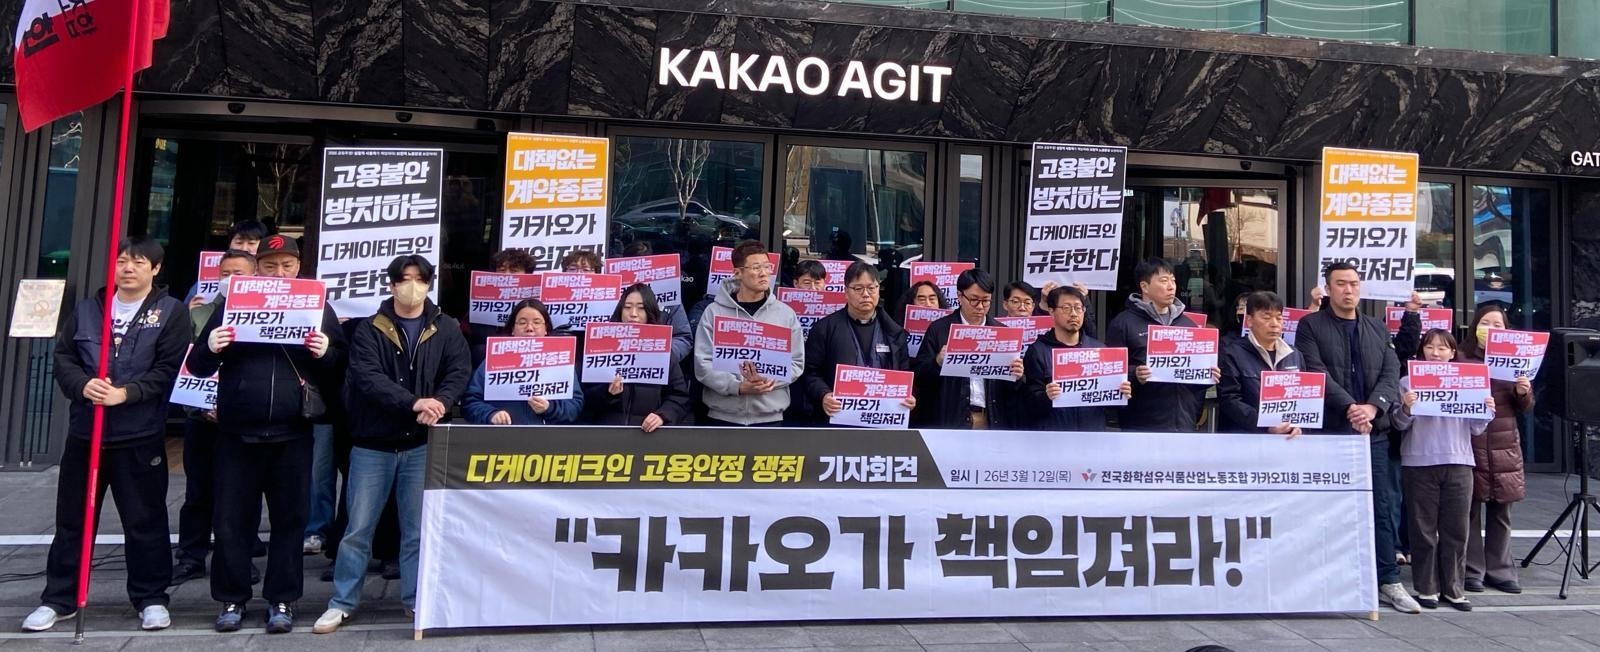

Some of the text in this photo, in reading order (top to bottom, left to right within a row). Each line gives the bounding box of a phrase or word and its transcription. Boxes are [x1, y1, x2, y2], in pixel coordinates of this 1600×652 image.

[659, 47, 952, 103] KAKAO AGIT
[513, 149, 596, 171] 대책없는
[1571, 151, 1600, 167] GAT
[331, 161, 430, 188] 고용불안
[1038, 157, 1116, 179] 고용불안
[1328, 163, 1408, 185] 대책없는
[507, 178, 603, 204] 계약종료
[1033, 185, 1121, 211] 방치하는
[325, 193, 437, 225] 방치하는
[1324, 192, 1415, 216] 계약종료
[509, 213, 596, 237] 카카오가
[1029, 223, 1117, 241] 디케이테크인
[1326, 227, 1407, 248] 카카오가
[320, 236, 433, 261] 디케이테크인
[609, 258, 652, 273] 대책없는
[1027, 248, 1119, 274] 규탄한다
[633, 266, 676, 282] 계약종료
[914, 264, 952, 276] 대책없는
[233, 280, 291, 294] 대책없는
[475, 275, 519, 287] 대책없는
[545, 275, 592, 288] 대책없는
[570, 287, 616, 300] 계약종료
[656, 291, 677, 303] 져라
[782, 291, 824, 303] 대책없는
[263, 294, 320, 308] 계약종료
[227, 311, 285, 325] 카카오가
[590, 325, 640, 339] 대책없는
[718, 321, 764, 335] 대책없는
[953, 328, 997, 340] 대책없는
[743, 334, 788, 351] 계약종료
[1152, 329, 1194, 342] 대책없는
[1491, 332, 1533, 344] 대책없는
[491, 339, 544, 355] 대책없는
[617, 338, 667, 351] 계약종료
[976, 340, 1019, 352] 계약종료
[1174, 341, 1215, 353] 계약종료
[520, 351, 570, 367] 계약종료
[586, 354, 636, 368] 카카오가
[715, 347, 761, 361] 카카오가
[946, 353, 991, 365] 카카오가
[1057, 350, 1100, 365] 대책없는
[743, 361, 787, 377] 임져라
[1081, 361, 1123, 375] 계약종료
[1149, 356, 1191, 368] 카카오가
[488, 370, 540, 385] 카카오가
[615, 367, 664, 379] 책임져라
[839, 369, 886, 384] 대책없는
[1413, 365, 1459, 376] 대책없는
[178, 377, 218, 392] 카카오
[1264, 374, 1301, 387] 대책없는
[1439, 376, 1485, 388] 계약종료
[518, 381, 569, 397] 책임져라
[864, 384, 908, 397] 계약종료
[1283, 385, 1321, 398] 계약종료
[1261, 401, 1297, 413] 카카오가
[1440, 402, 1487, 414] 책임져라
[860, 412, 905, 425] 책임져라
[1282, 412, 1319, 424] 책임져라
[466, 454, 918, 484] 디케이테크인 고용안정 쟁취 기자회견
[950, 469, 1072, 483] 일시 26년 3월 12일(목)
[1101, 470, 1350, 485] 전국화학섬유식품산업노동조합 카카오지회 크루유니언
[555, 513, 1273, 592] "카카오가 책임져라!"
